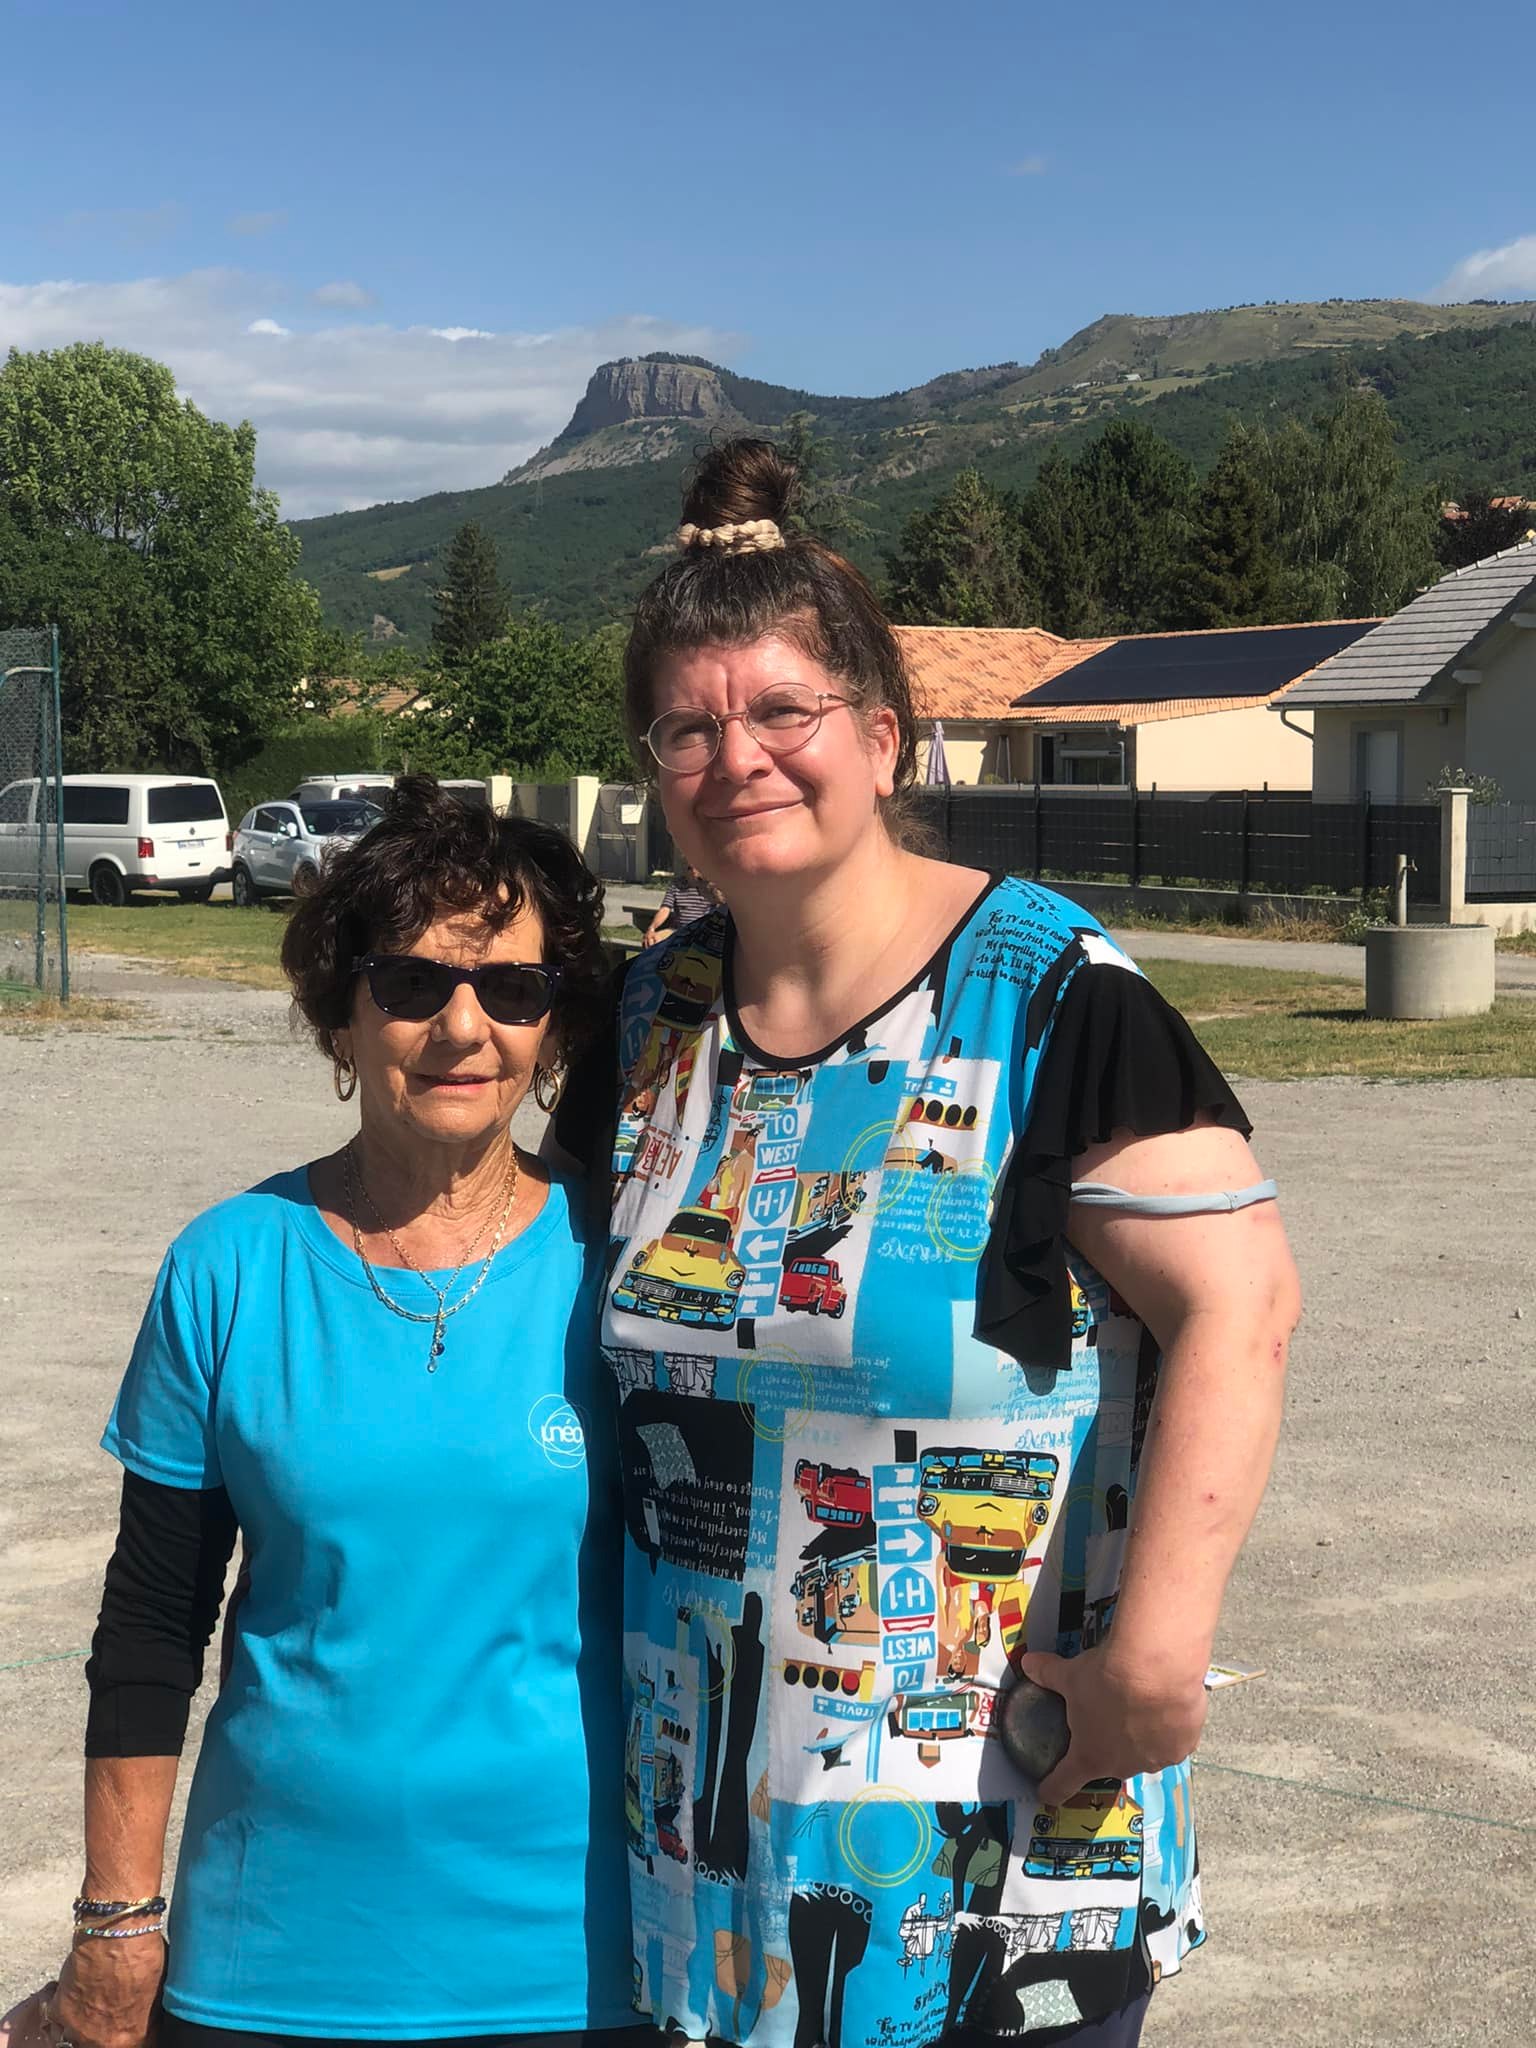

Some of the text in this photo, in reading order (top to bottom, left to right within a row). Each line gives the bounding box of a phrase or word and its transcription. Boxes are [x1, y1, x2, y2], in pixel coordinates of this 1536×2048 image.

[1007, 915, 1020, 923] TV
[773, 1112, 796, 1138] TO
[760, 1144, 799, 1166] WEST
[754, 1187, 786, 1218] H-1
[752, 1530, 767, 1545] My
[887, 1577, 925, 1610] H-1
[885, 1636, 932, 1660] WEST
[897, 1669, 919, 1687] TO
